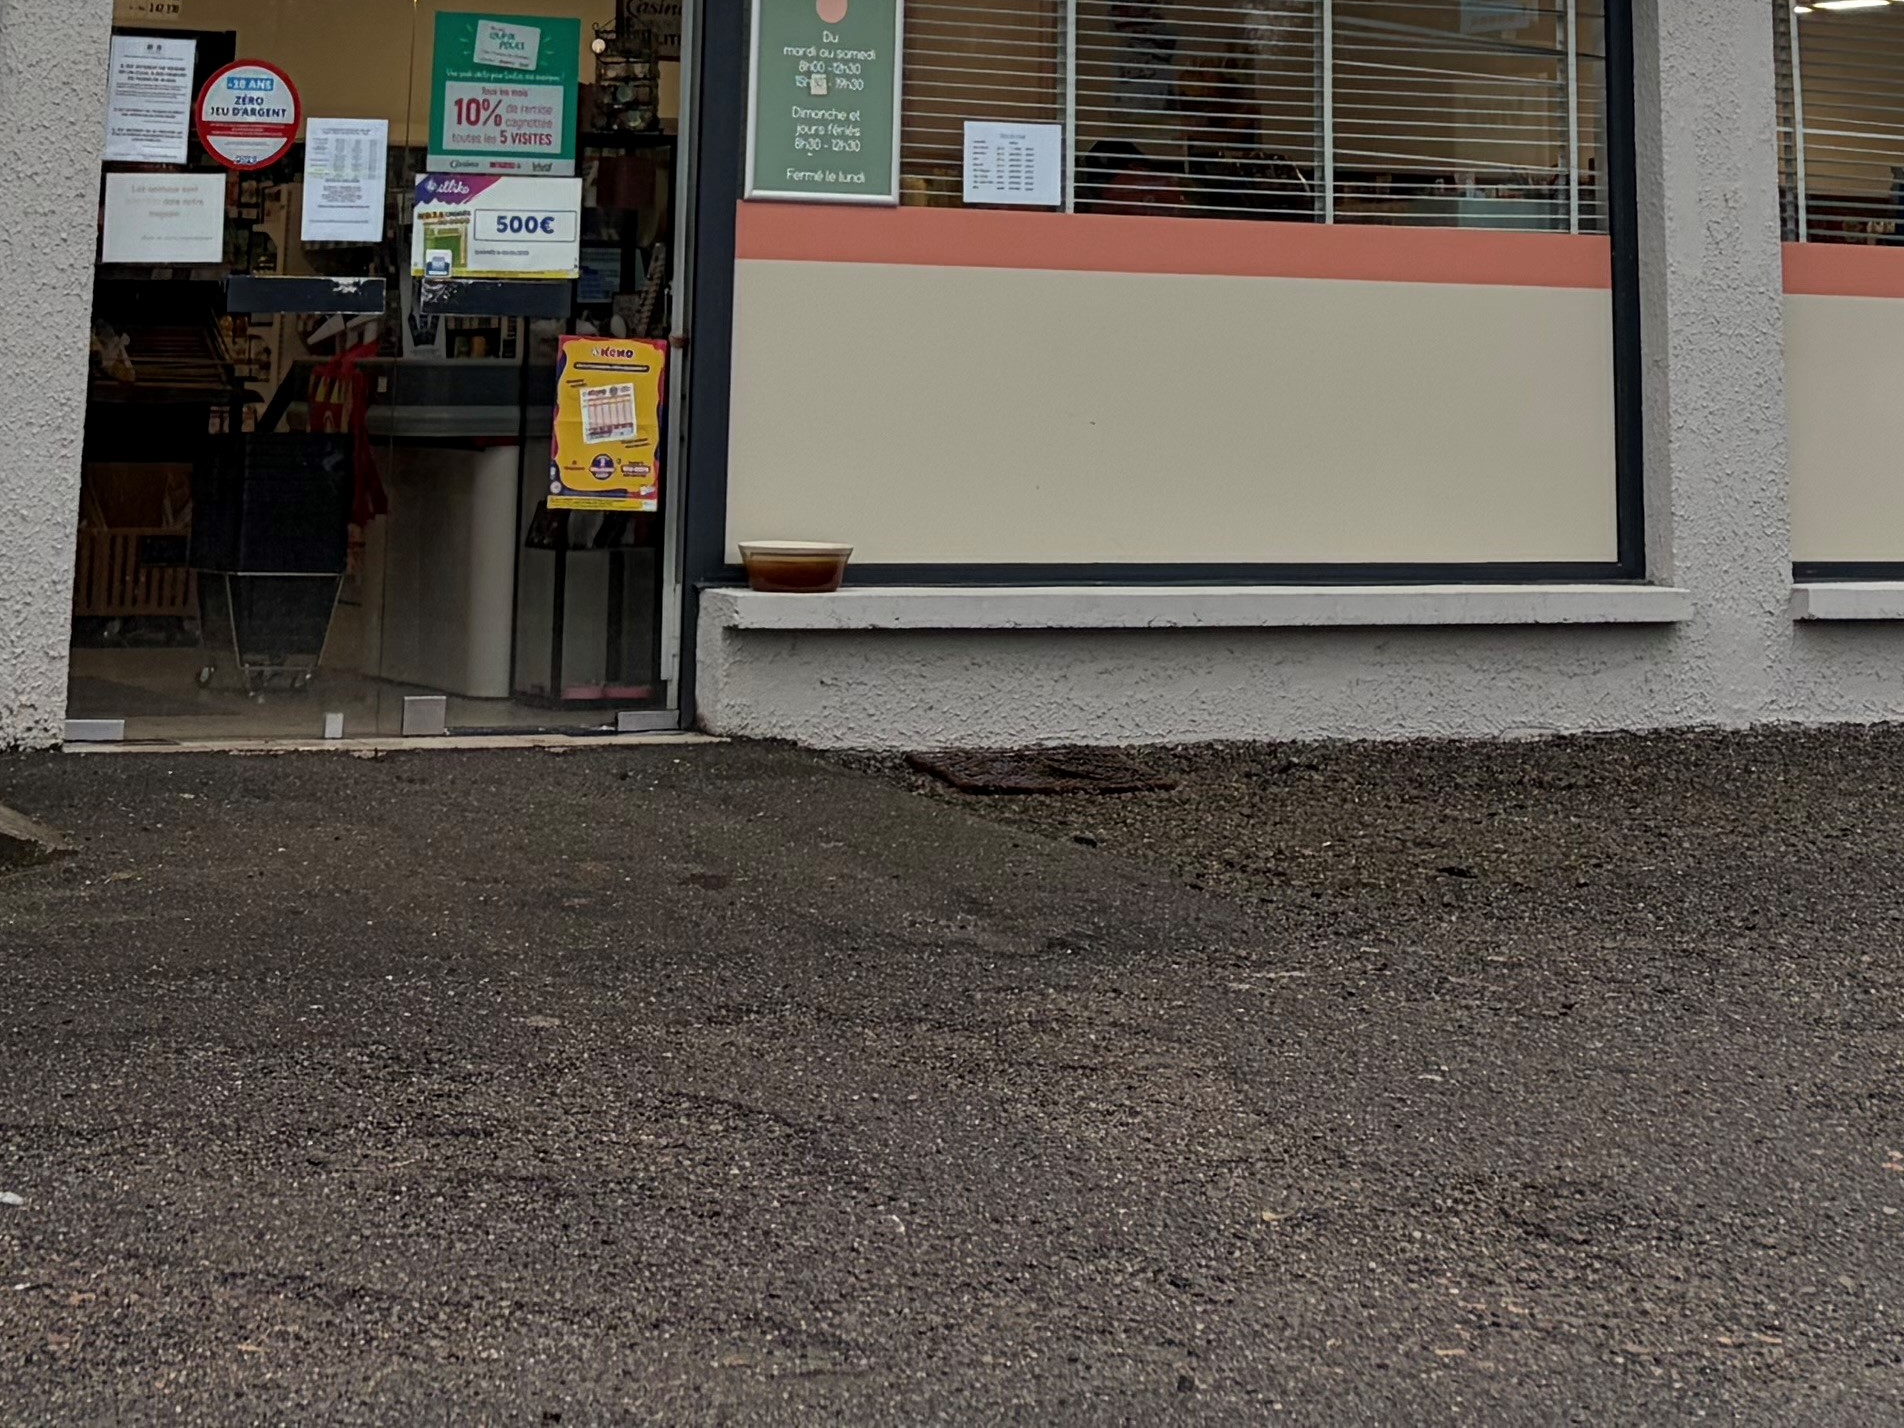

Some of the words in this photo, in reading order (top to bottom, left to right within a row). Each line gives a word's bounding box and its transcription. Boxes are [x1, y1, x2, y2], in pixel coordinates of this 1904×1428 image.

[823, 30, 839, 43] Du
[819, 48, 834, 58] au
[248, 78, 272, 90] ANS
[234, 94, 265, 106] ZÉRO
[210, 106, 230, 117] JEU
[231, 107, 287, 118] D'ARGENT
[454, 97, 503, 127] 10%
[506, 104, 518, 114] de
[520, 105, 553, 115] remise
[792, 105, 847, 120] Dimanche
[849, 110, 861, 122] et
[795, 124, 826, 137] jours
[499, 130, 508, 144] 5
[510, 133, 553, 146] VISITES
[786, 167, 824, 182] Fermé
[825, 170, 836, 183] le
[496, 215, 556, 235] 500€
